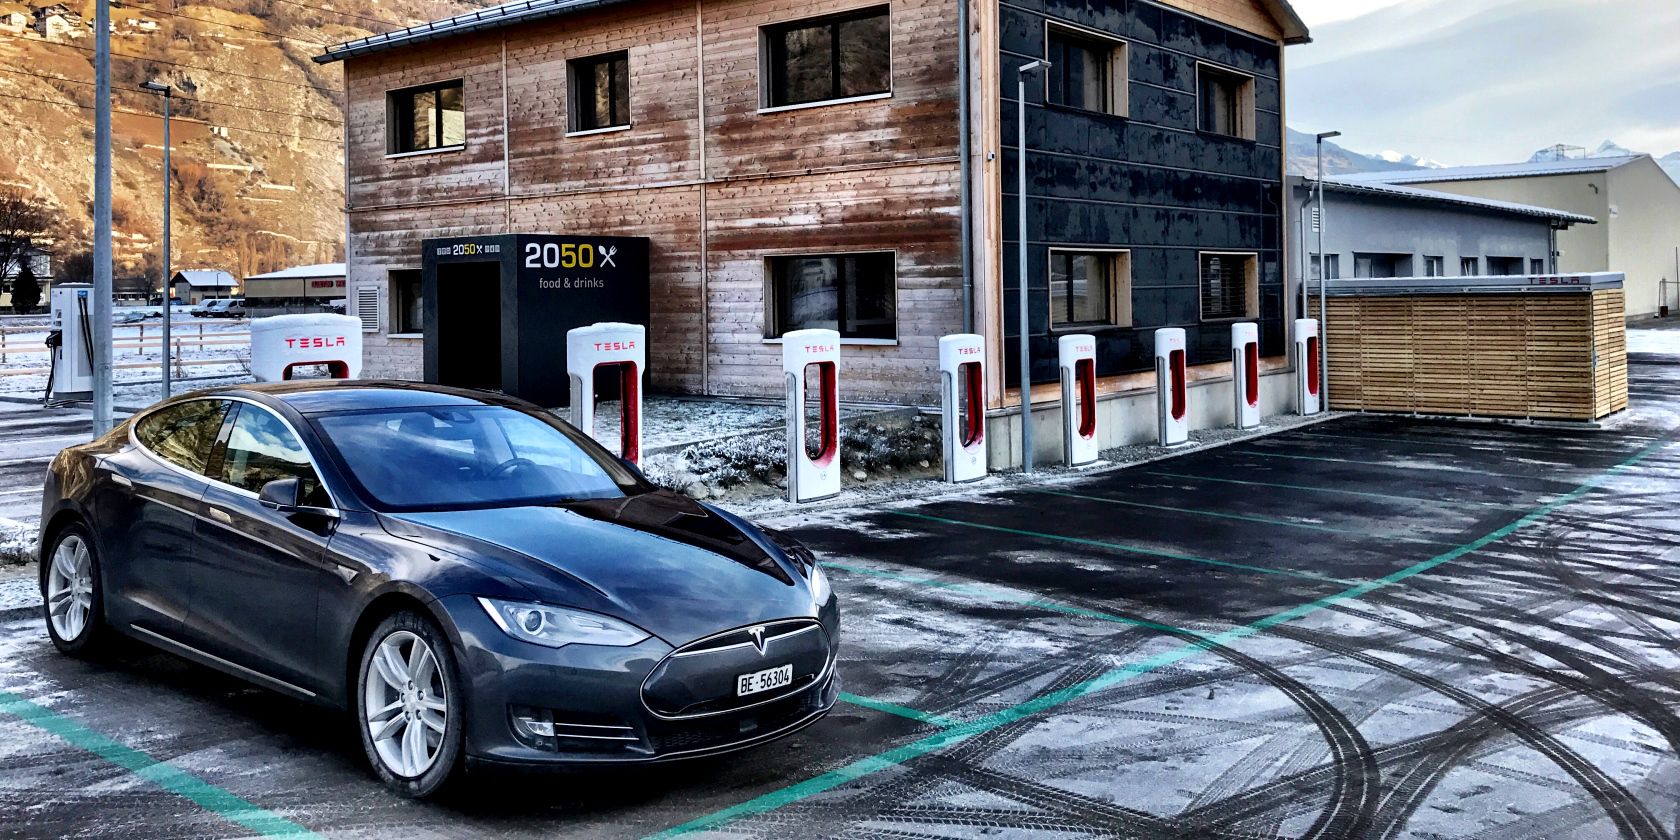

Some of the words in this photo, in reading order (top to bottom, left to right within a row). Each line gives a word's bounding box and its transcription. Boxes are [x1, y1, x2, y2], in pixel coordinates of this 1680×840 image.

[453, 244, 476, 256] 2050
[525, 243, 594, 268] 2050
[539, 277, 561, 288] food
[563, 278, 571, 288] &
[574, 277, 604, 288] drinks
[1527, 277, 1580, 285] TESLA
[285, 337, 345, 349] TESLA
[594, 341, 635, 351] TESLA
[804, 345, 834, 353] TESLA
